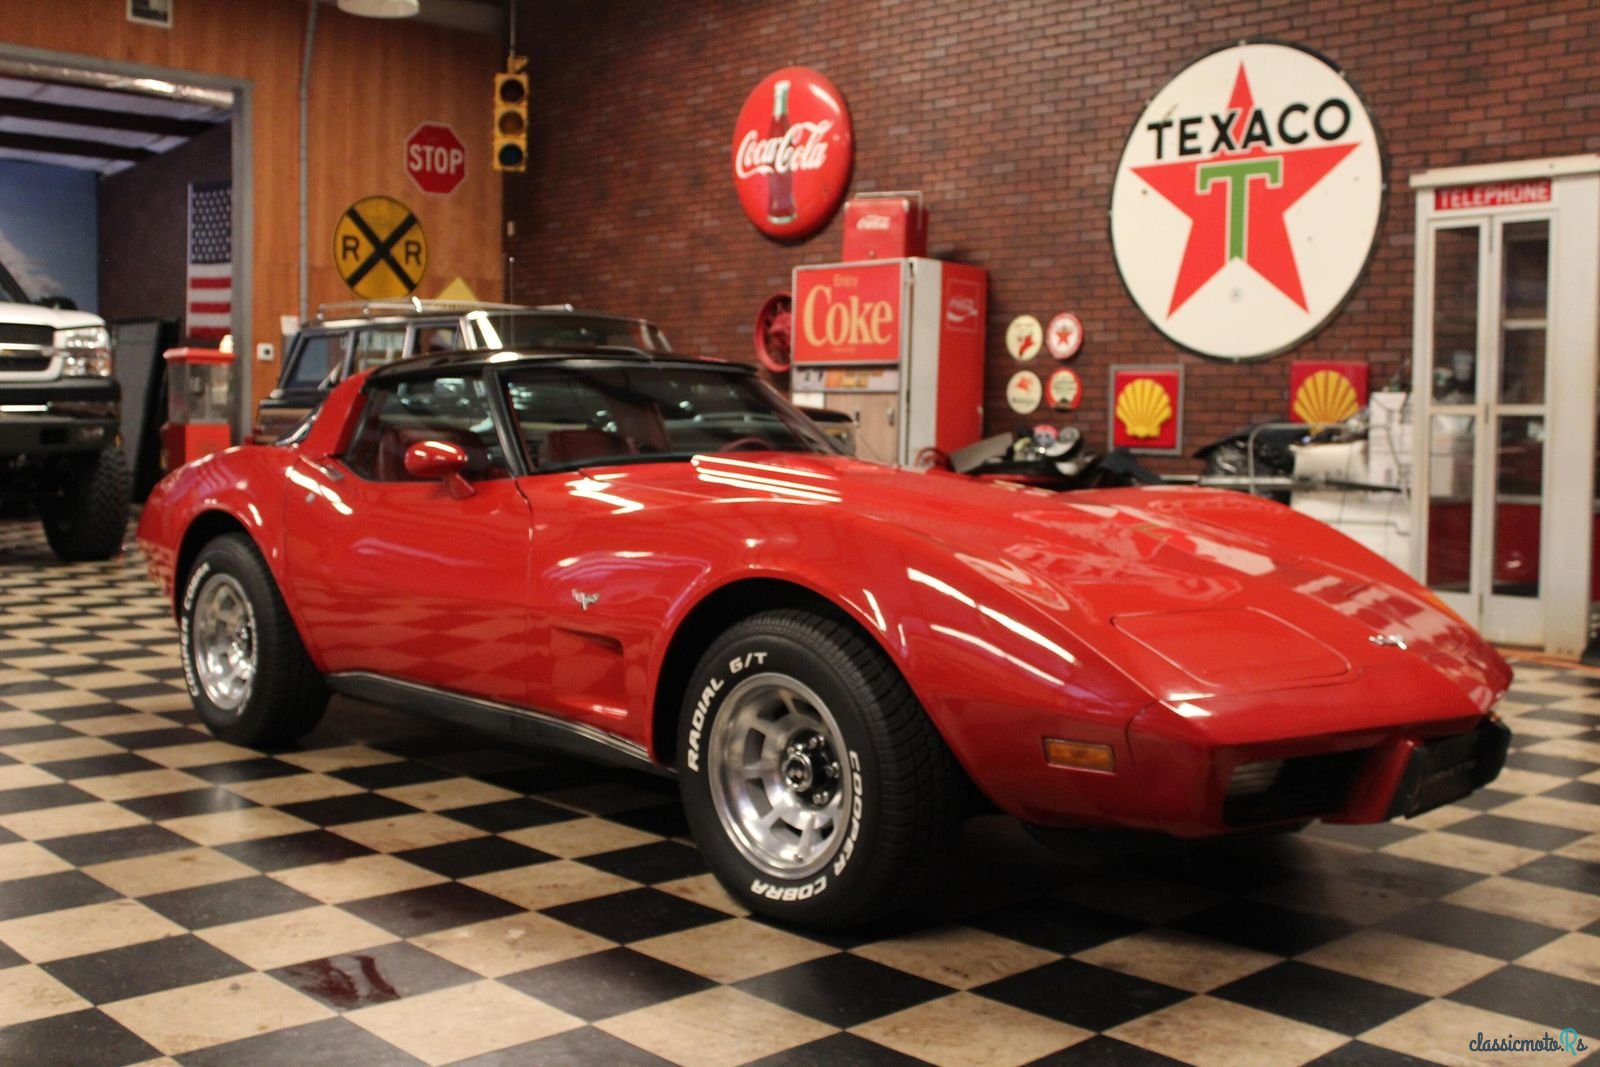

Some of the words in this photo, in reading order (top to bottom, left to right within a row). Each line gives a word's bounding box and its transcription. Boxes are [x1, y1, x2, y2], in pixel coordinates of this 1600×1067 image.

[409, 144, 463, 174] STOP
[735, 119, 834, 179] Coca-Cola
[1147, 98, 1351, 160] TEXACO
[1438, 181, 1550, 209] TELEPHONE
[342, 236, 359, 261] R
[404, 241, 421, 266] R
[803, 284, 893, 347] Coke
[687, 678, 724, 772] RADIAL
[833, 750, 863, 876] COOPER
[750, 876, 827, 901] COBRA
